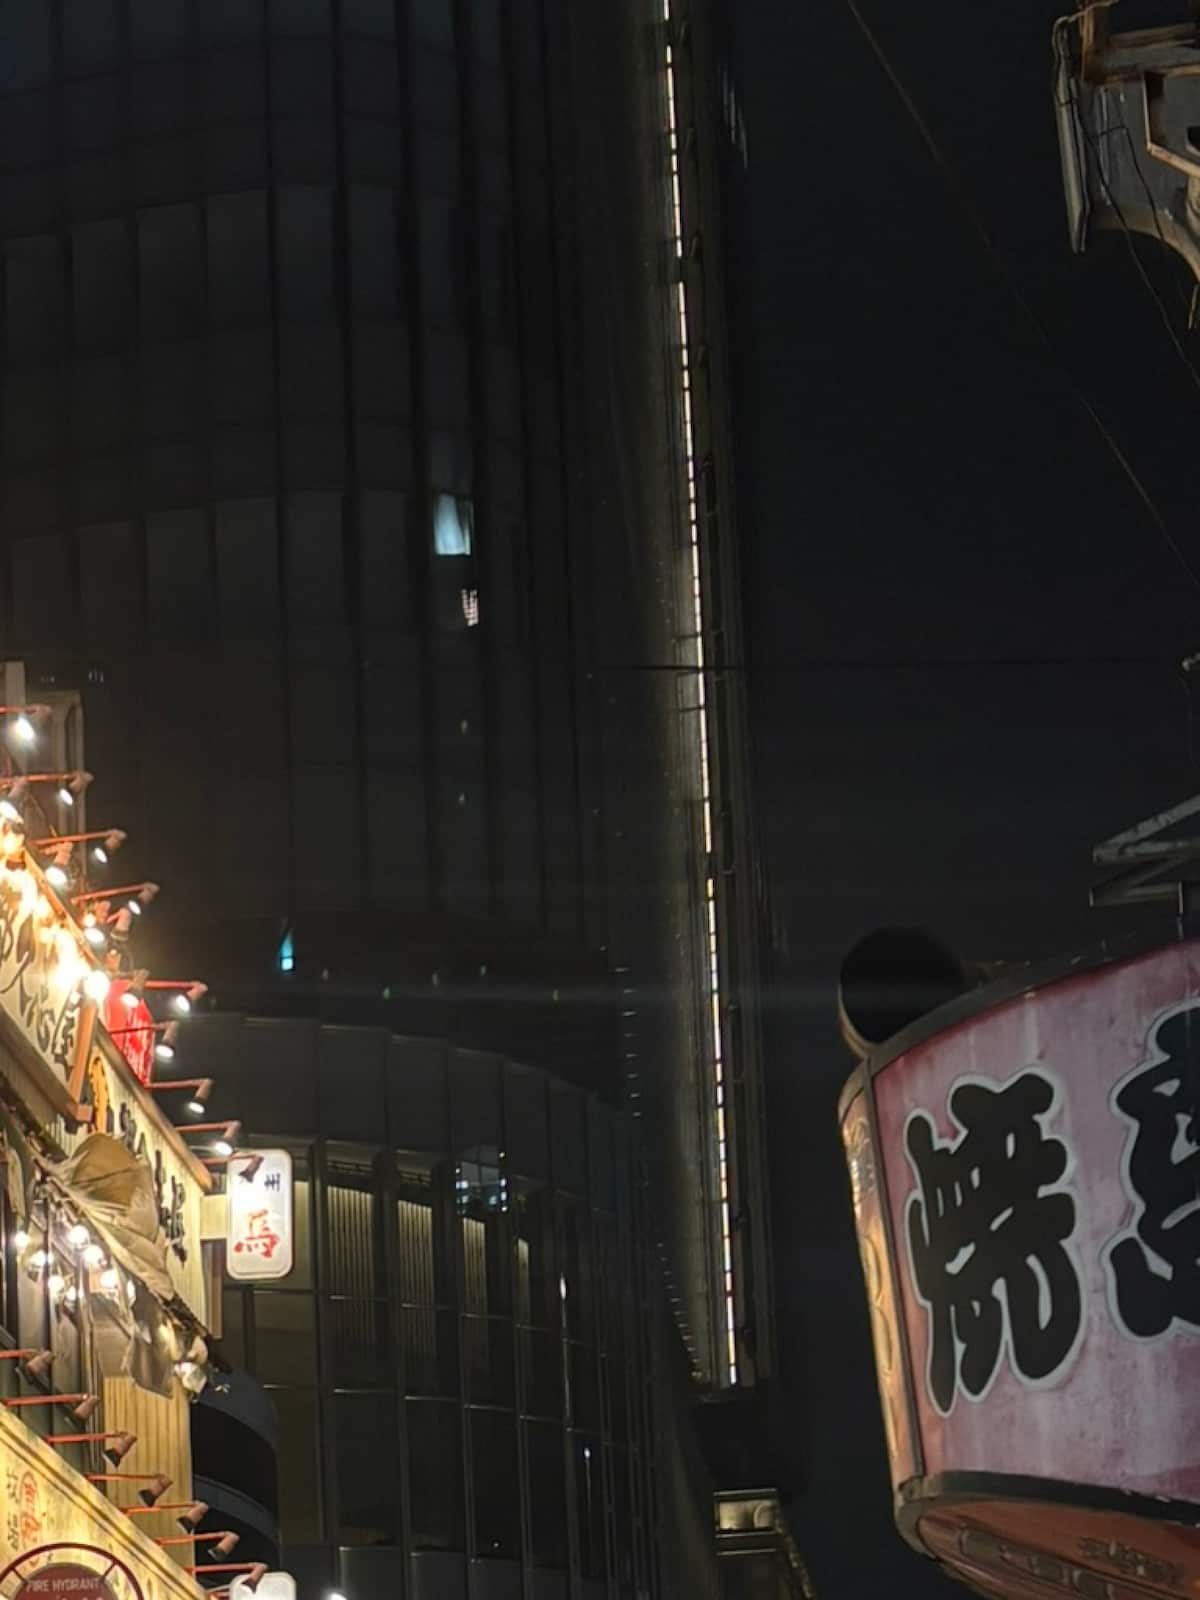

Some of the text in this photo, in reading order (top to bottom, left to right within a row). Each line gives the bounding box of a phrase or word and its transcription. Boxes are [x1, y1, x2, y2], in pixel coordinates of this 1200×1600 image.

[233, 1208, 280, 1259] 馬
[26, 1577, 102, 1593] FIRE HYDRANT
